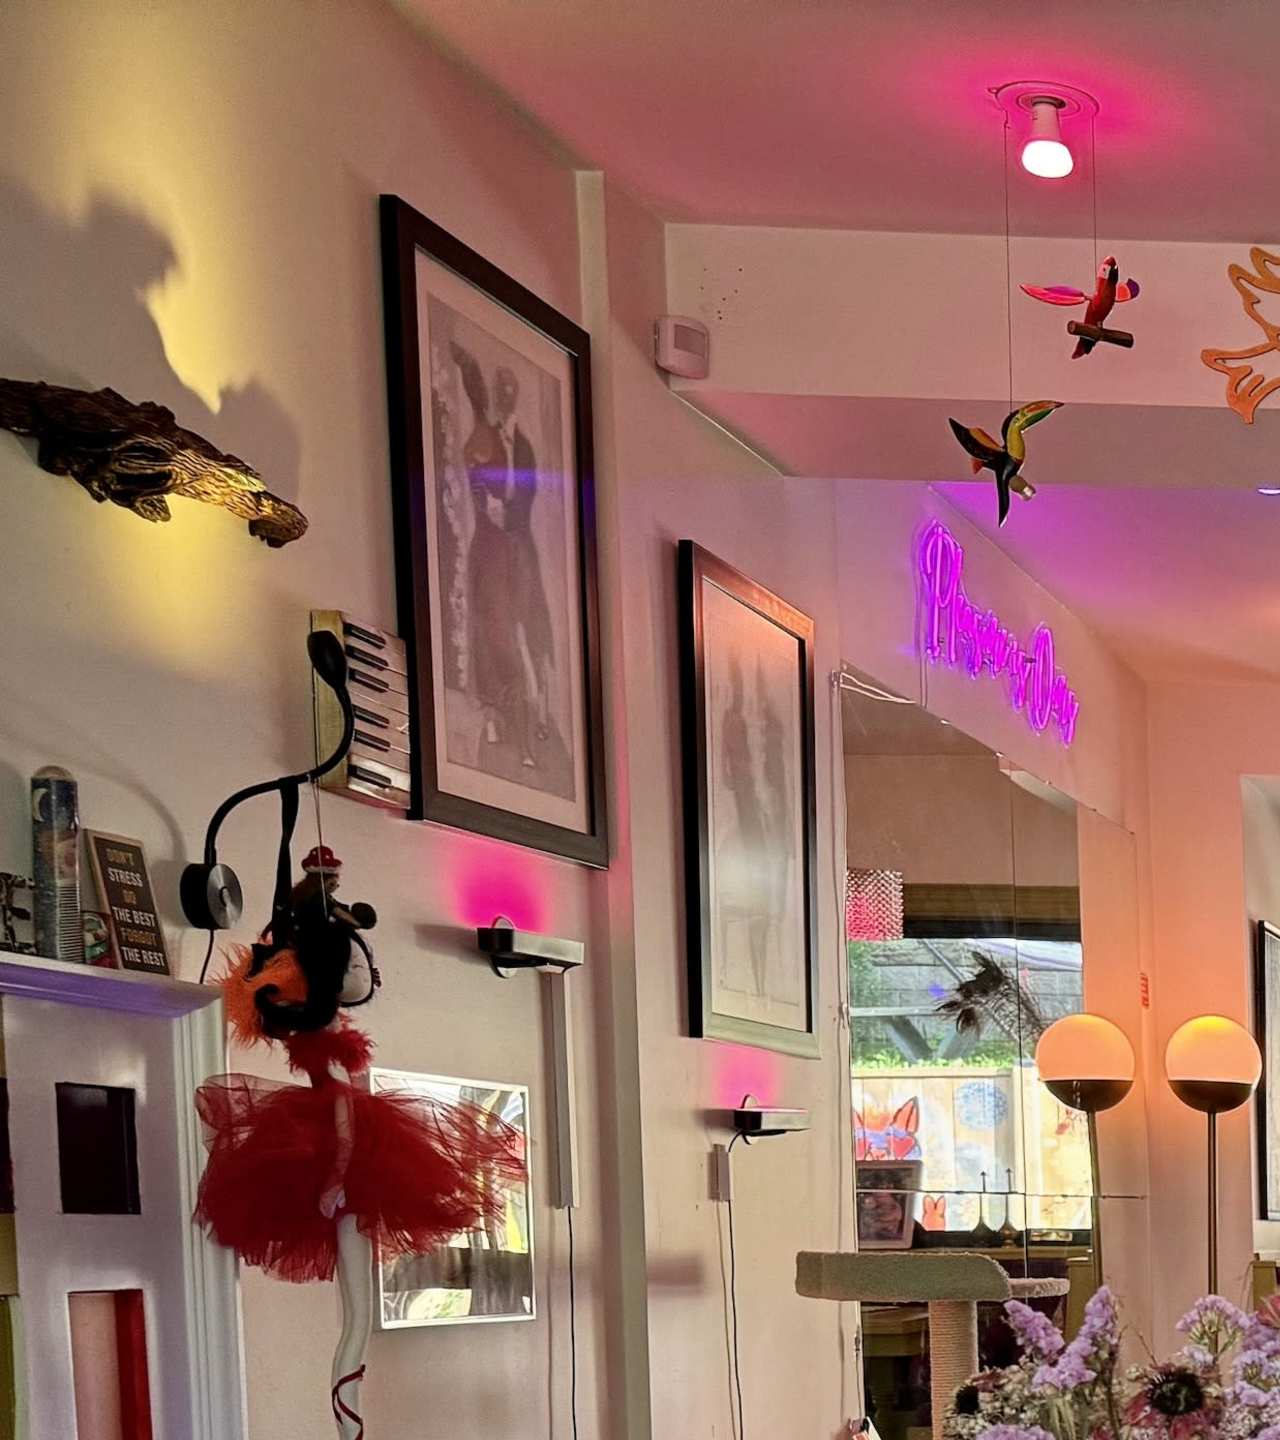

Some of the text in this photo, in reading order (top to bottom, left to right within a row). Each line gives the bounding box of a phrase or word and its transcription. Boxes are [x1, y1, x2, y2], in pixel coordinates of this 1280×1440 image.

[107, 867, 143, 887] STRESS
[112, 906, 156, 927] THE BEST
[121, 946, 165, 967] THE REST
